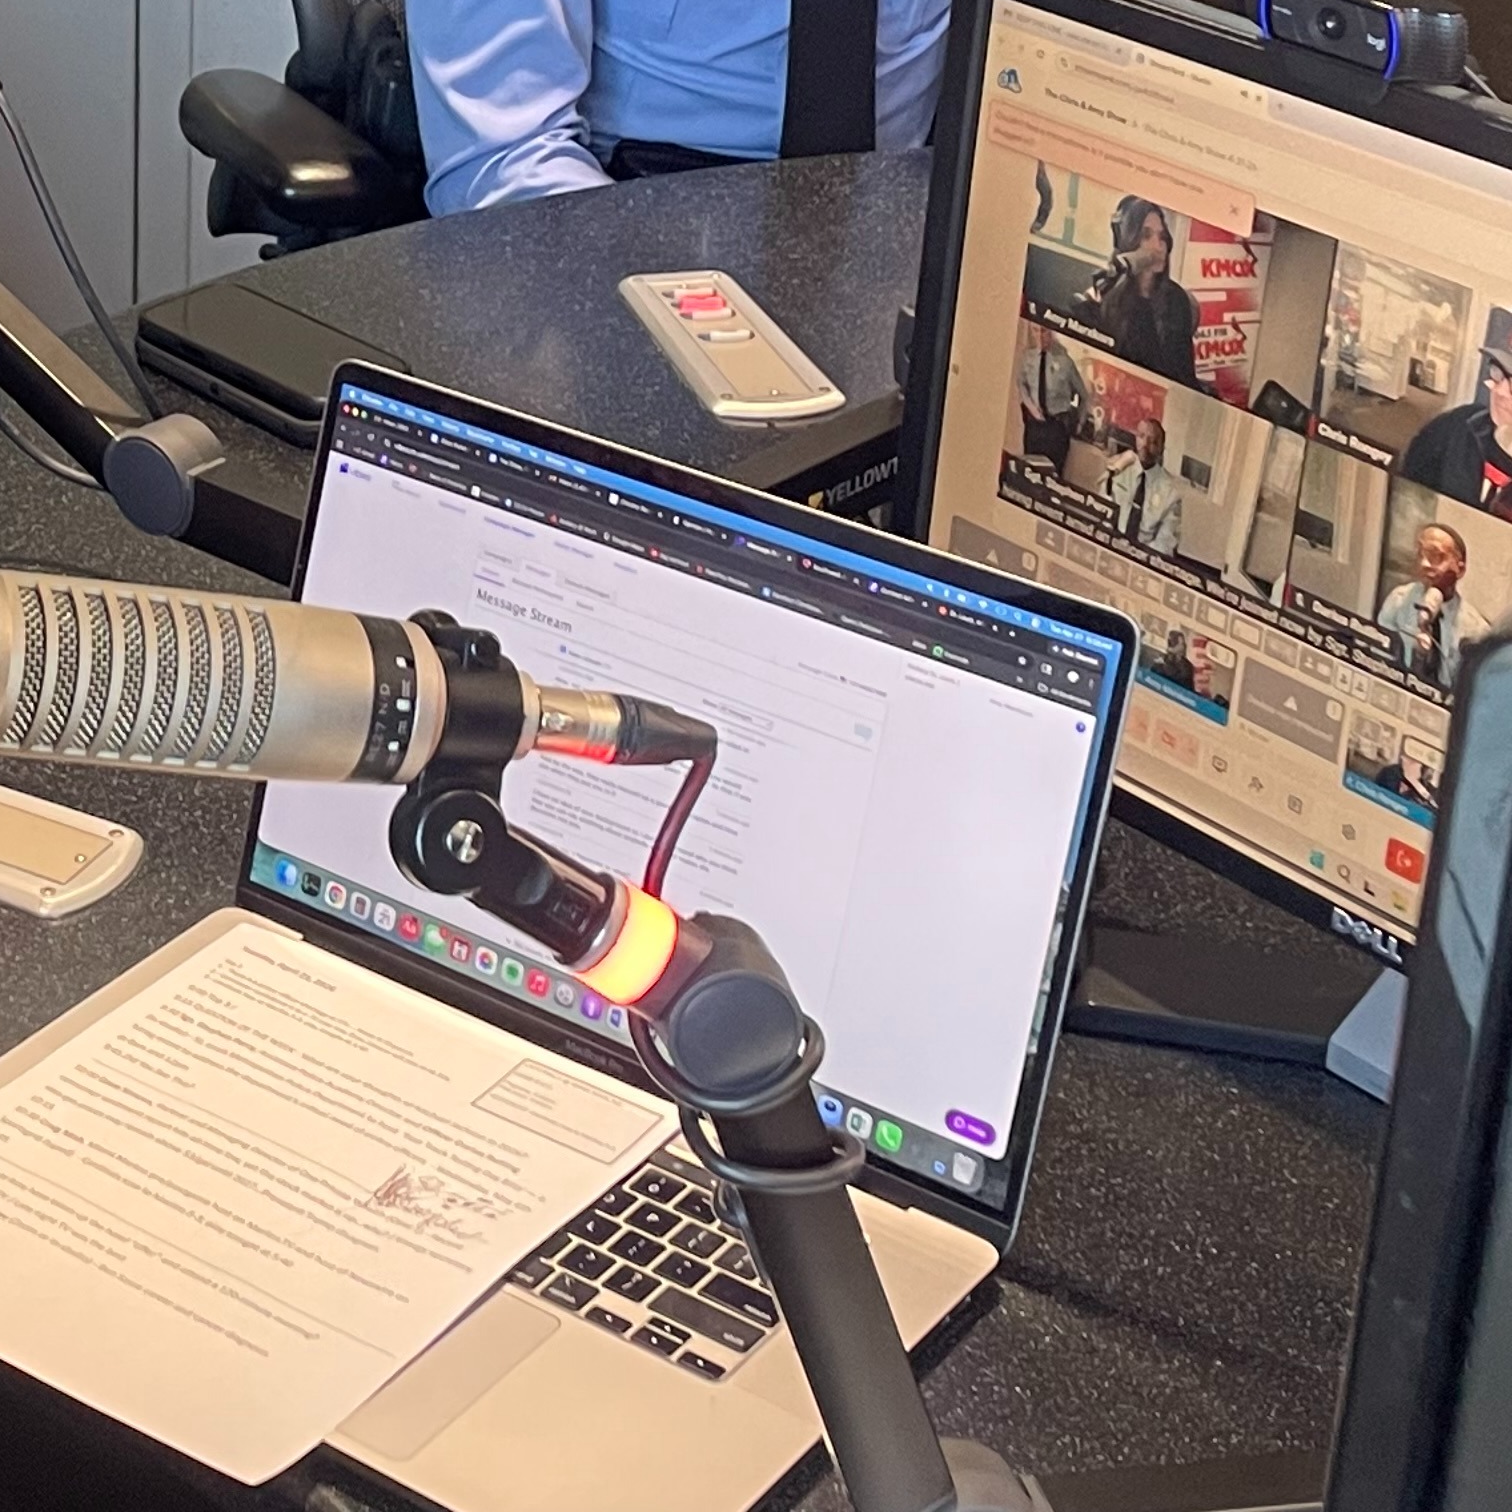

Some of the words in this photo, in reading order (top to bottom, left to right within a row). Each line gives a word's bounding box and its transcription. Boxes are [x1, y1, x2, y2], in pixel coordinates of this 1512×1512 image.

[1201, 257, 1257, 278] KMOX
[1044, 309, 1067, 328] Amy
[1318, 422, 1348, 445] Chris
[1086, 494, 1113, 519] Perry
[476, 588, 526, 617] Message
[529, 607, 573, 633] Stream
[1278, 615, 1306, 637] now
[1307, 625, 1323, 647] by
[1331, 906, 1403, 965] DELL
